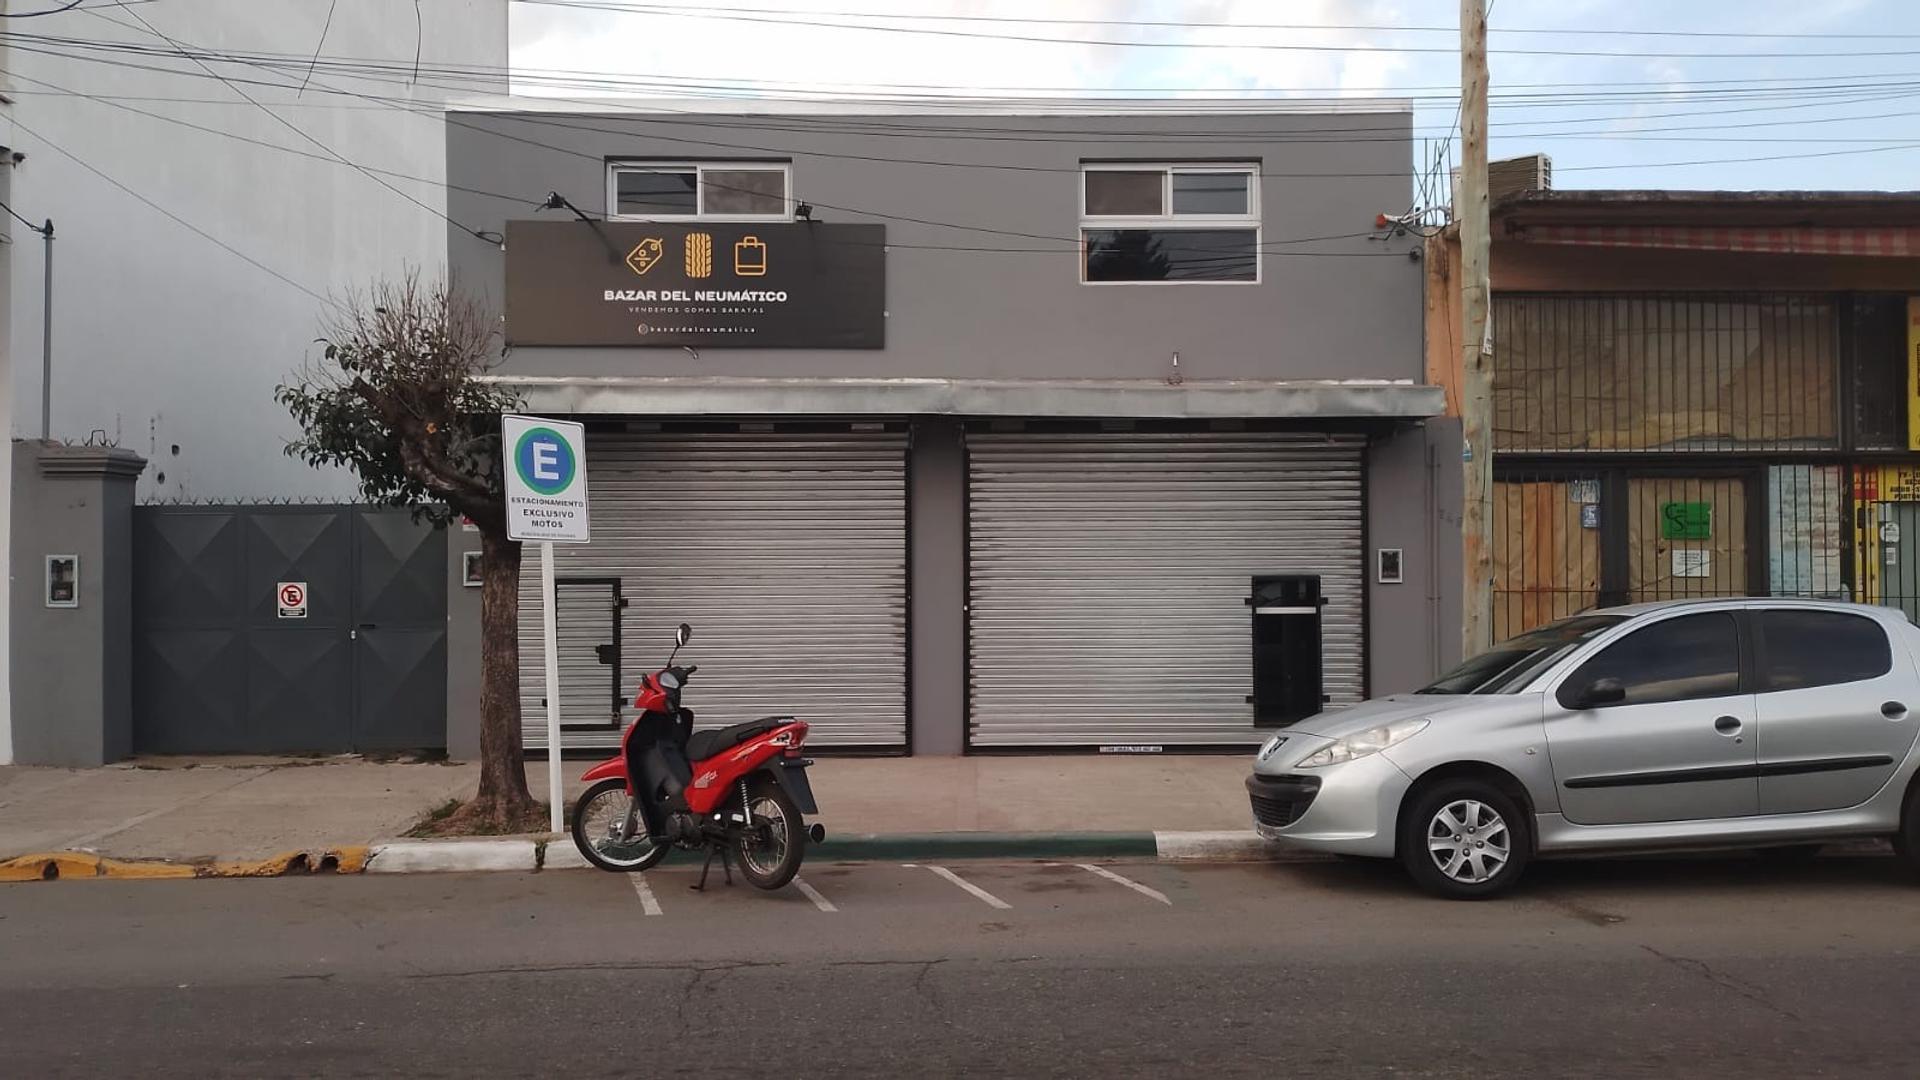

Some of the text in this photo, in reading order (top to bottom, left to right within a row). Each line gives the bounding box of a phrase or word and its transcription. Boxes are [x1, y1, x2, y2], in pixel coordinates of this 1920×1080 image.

[604, 289, 788, 302] BAZAR DEL NEUMÁTICO
[532, 441, 560, 480] E
[511, 497, 584, 507] ESTACIONAMIENTO
[523, 508, 574, 518] EXCLUSIVO
[531, 520, 563, 528] MOTOS
